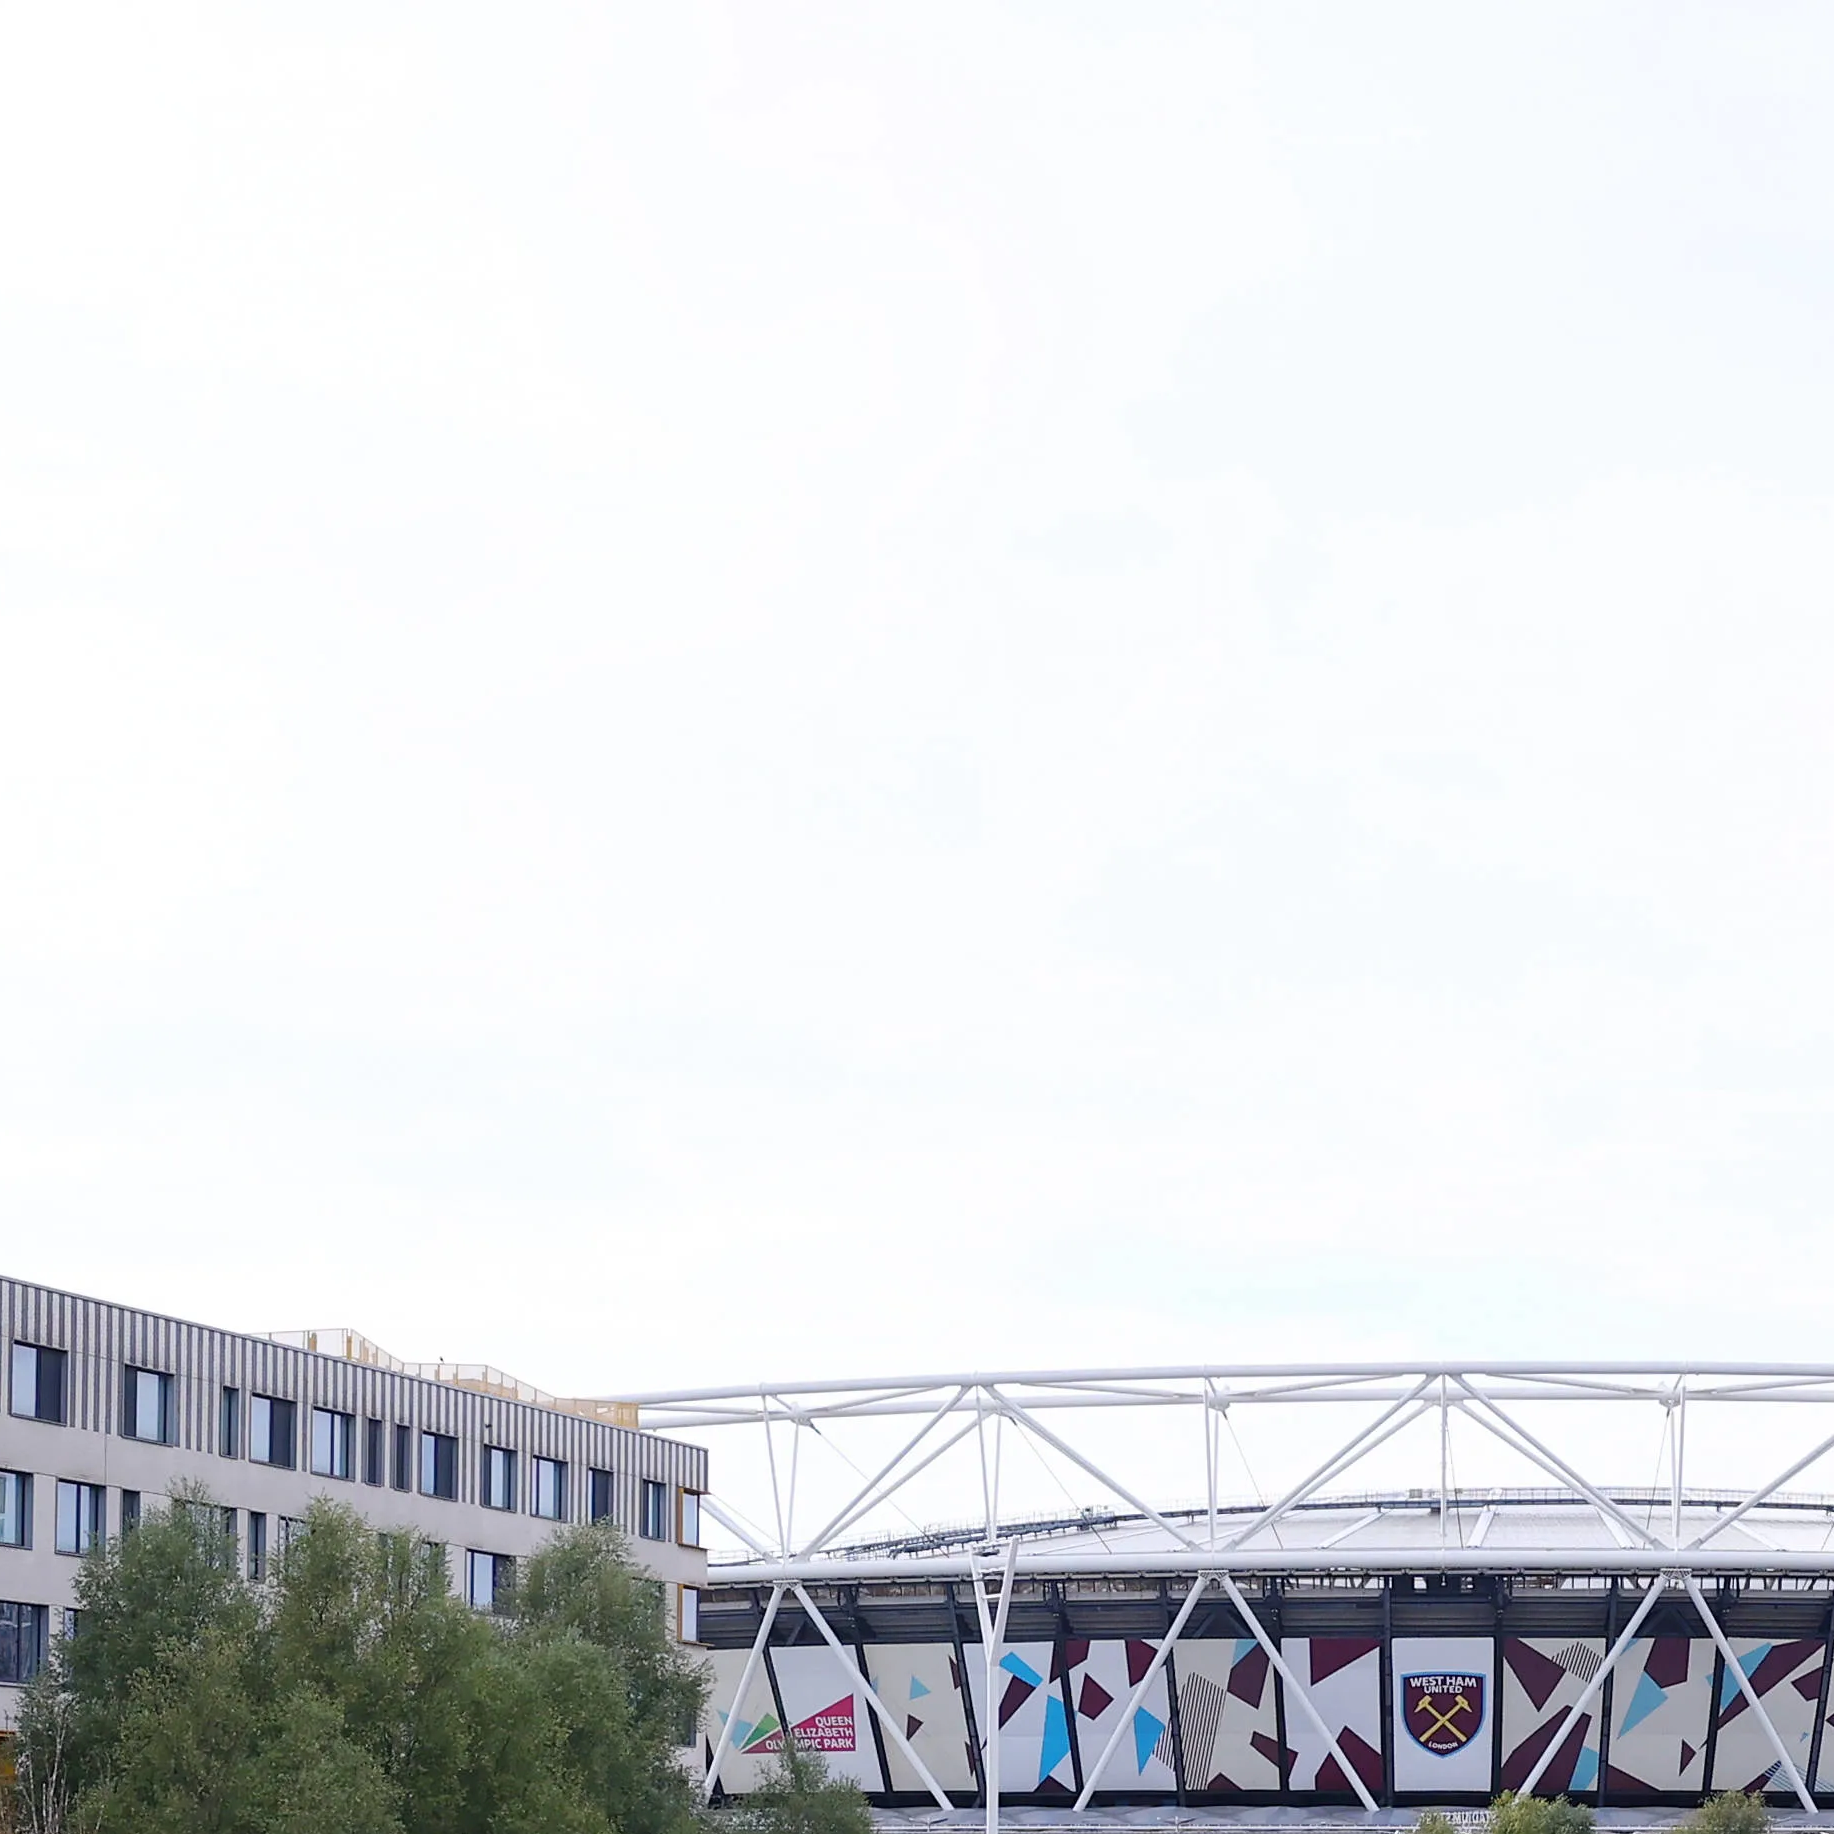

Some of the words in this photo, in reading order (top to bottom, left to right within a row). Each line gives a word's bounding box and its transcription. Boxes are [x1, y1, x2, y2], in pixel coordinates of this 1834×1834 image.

[1410, 1676, 1445, 1688] WEST
[1446, 1676, 1477, 1688] HAM
[1423, 1685, 1463, 1694] UNITED
[815, 1716, 854, 1726] QUEEN
[794, 1728, 854, 1738] ELIZABETH
[824, 1738, 854, 1748] PARK
[1428, 1741, 1459, 1750] LONDON
